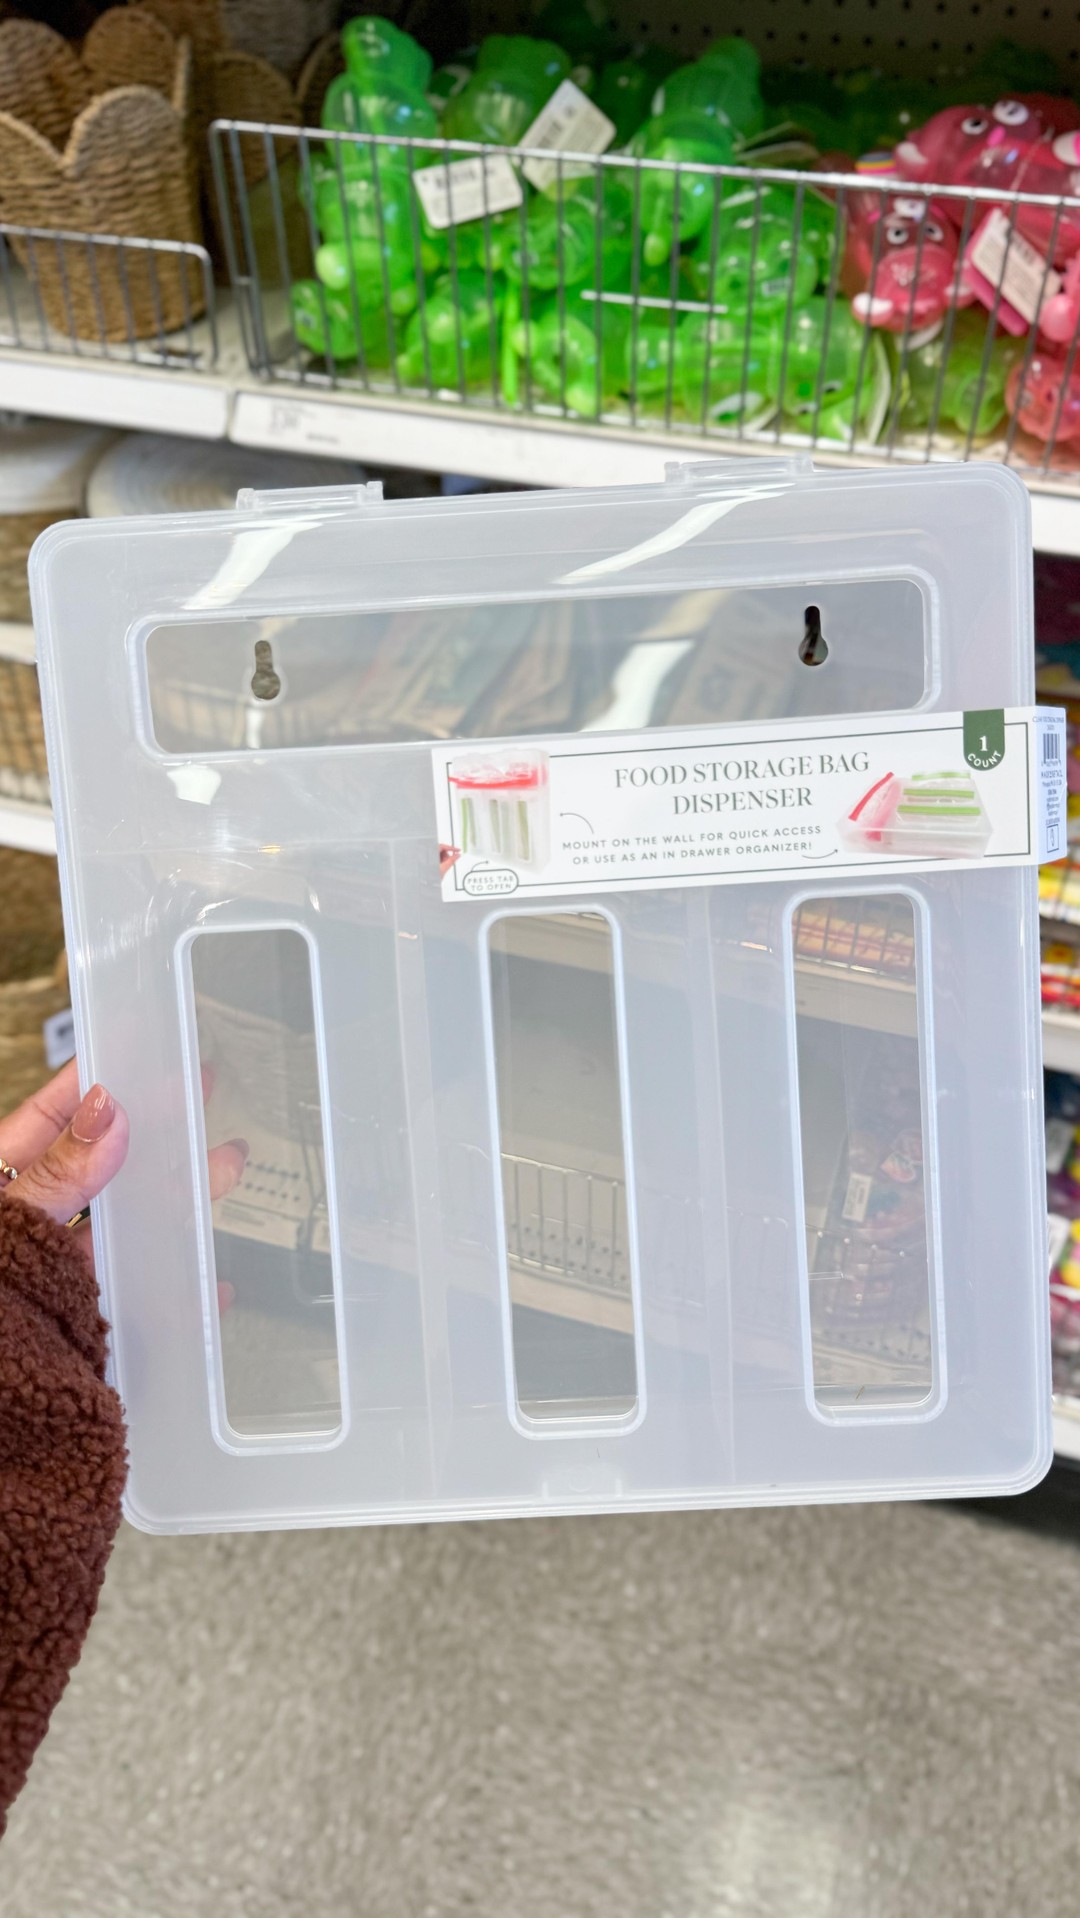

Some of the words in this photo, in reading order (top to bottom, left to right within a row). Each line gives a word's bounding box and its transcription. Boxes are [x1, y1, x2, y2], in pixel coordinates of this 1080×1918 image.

[979, 735, 988, 751] 1
[967, 750, 1001, 768] COUNT
[614, 765, 687, 788] FOOD
[693, 755, 813, 784] STORAGE
[819, 751, 869, 775] BAG
[673, 787, 812, 815] DISPENSER
[562, 840, 607, 850] MOUNT
[612, 838, 630, 848] ON
[635, 836, 657, 846] THE
[662, 834, 695, 844] WALL
[700, 832, 723, 841] FOR
[729, 829, 768, 840] QUICK
[774, 825, 821, 837] ACCESS
[573, 856, 589, 865] OR
[594, 854, 616, 864] USE
[621, 853, 636, 862] AS
[641, 851, 657, 861] AN
[663, 850, 675, 859] IN
[680, 847, 730, 858] DRAWER
[736, 842, 812, 855] ORGANIZER!
[468, 876, 494, 884] PRESS
[487, 883, 511, 891] OPEN
